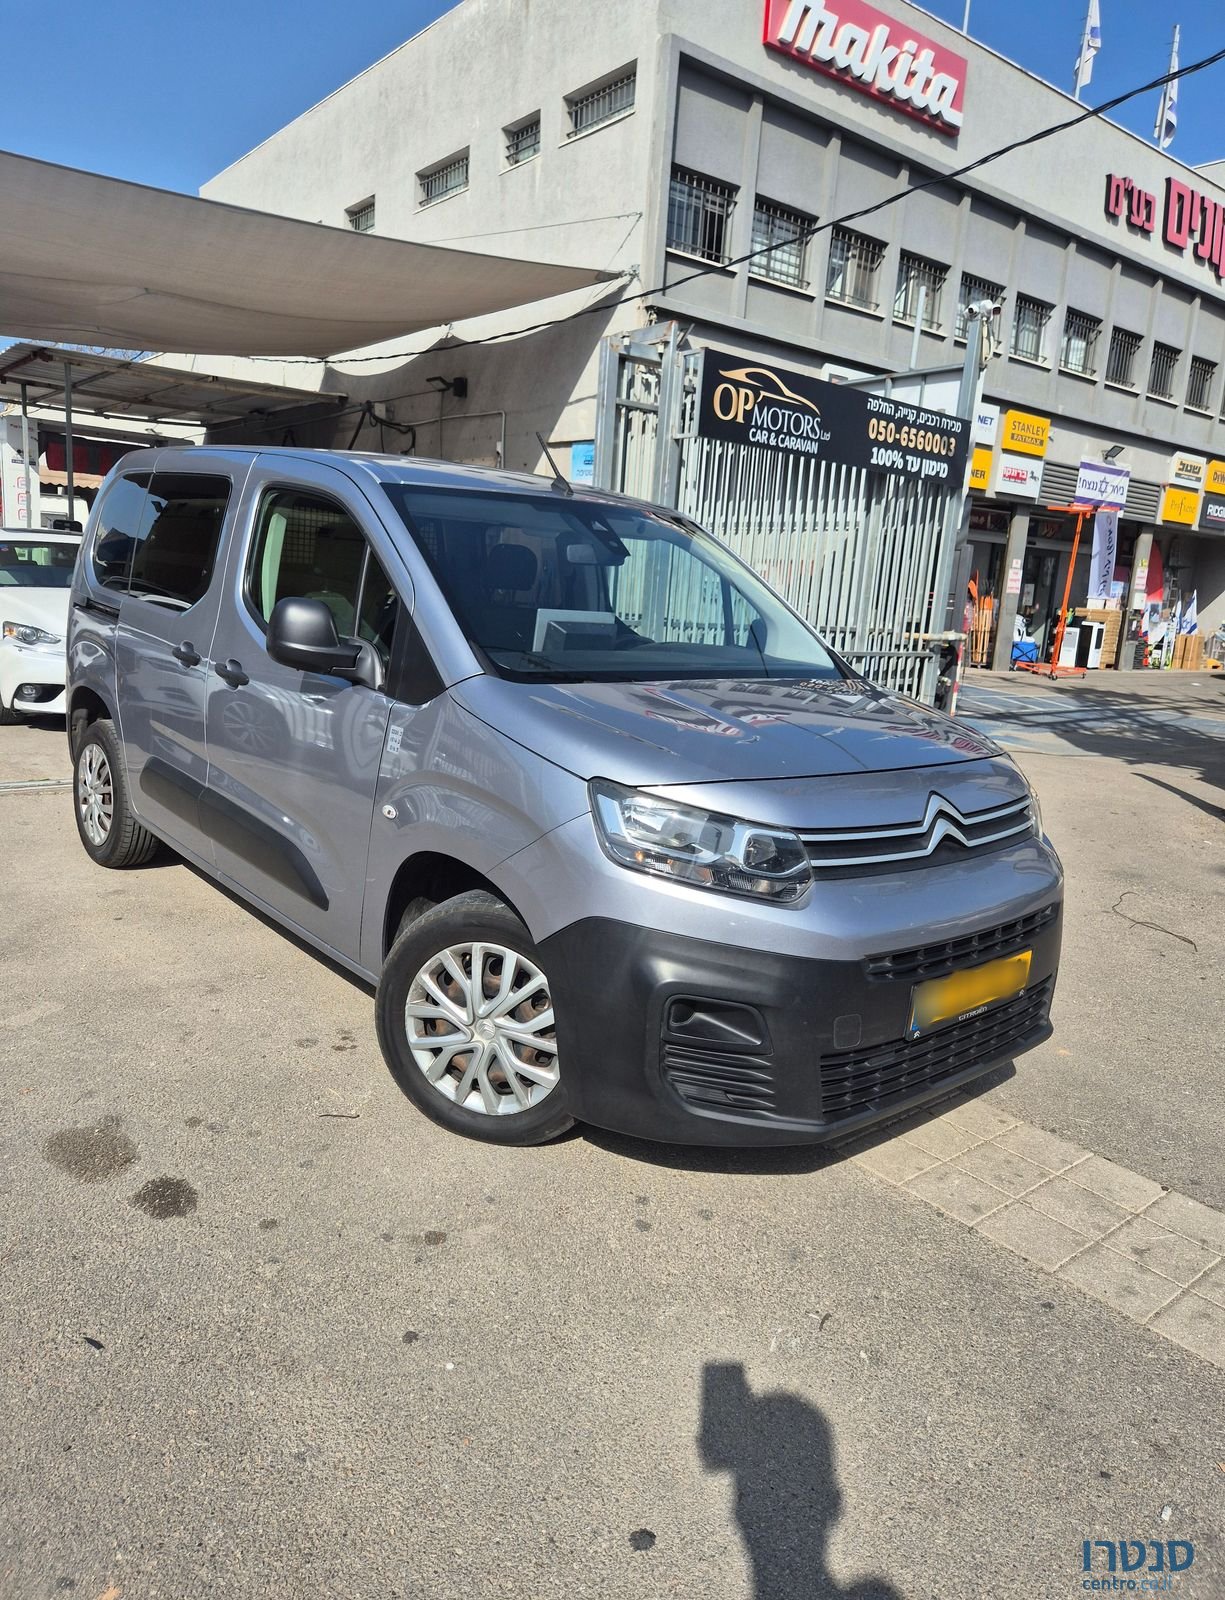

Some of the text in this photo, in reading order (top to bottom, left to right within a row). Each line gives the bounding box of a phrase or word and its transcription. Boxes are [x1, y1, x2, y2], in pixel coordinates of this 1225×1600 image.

[777, 0, 963, 128] makita
[1105, 174, 1225, 278] ונים בע"מ
[713, 383, 755, 424] OP
[867, 398, 962, 433] מכירת רכבים, קנייה, החלפה
[977, 414, 995, 426] NET
[752, 403, 831, 441] MOTORS Ltd
[868, 417, 956, 457] 050-6560003
[1012, 420, 1046, 438] STANLEY
[1013, 433, 1043, 446] FATMAX
[749, 428, 818, 454] CAR & CARAVAN
[870, 446, 949, 479] מימון עד 100%
